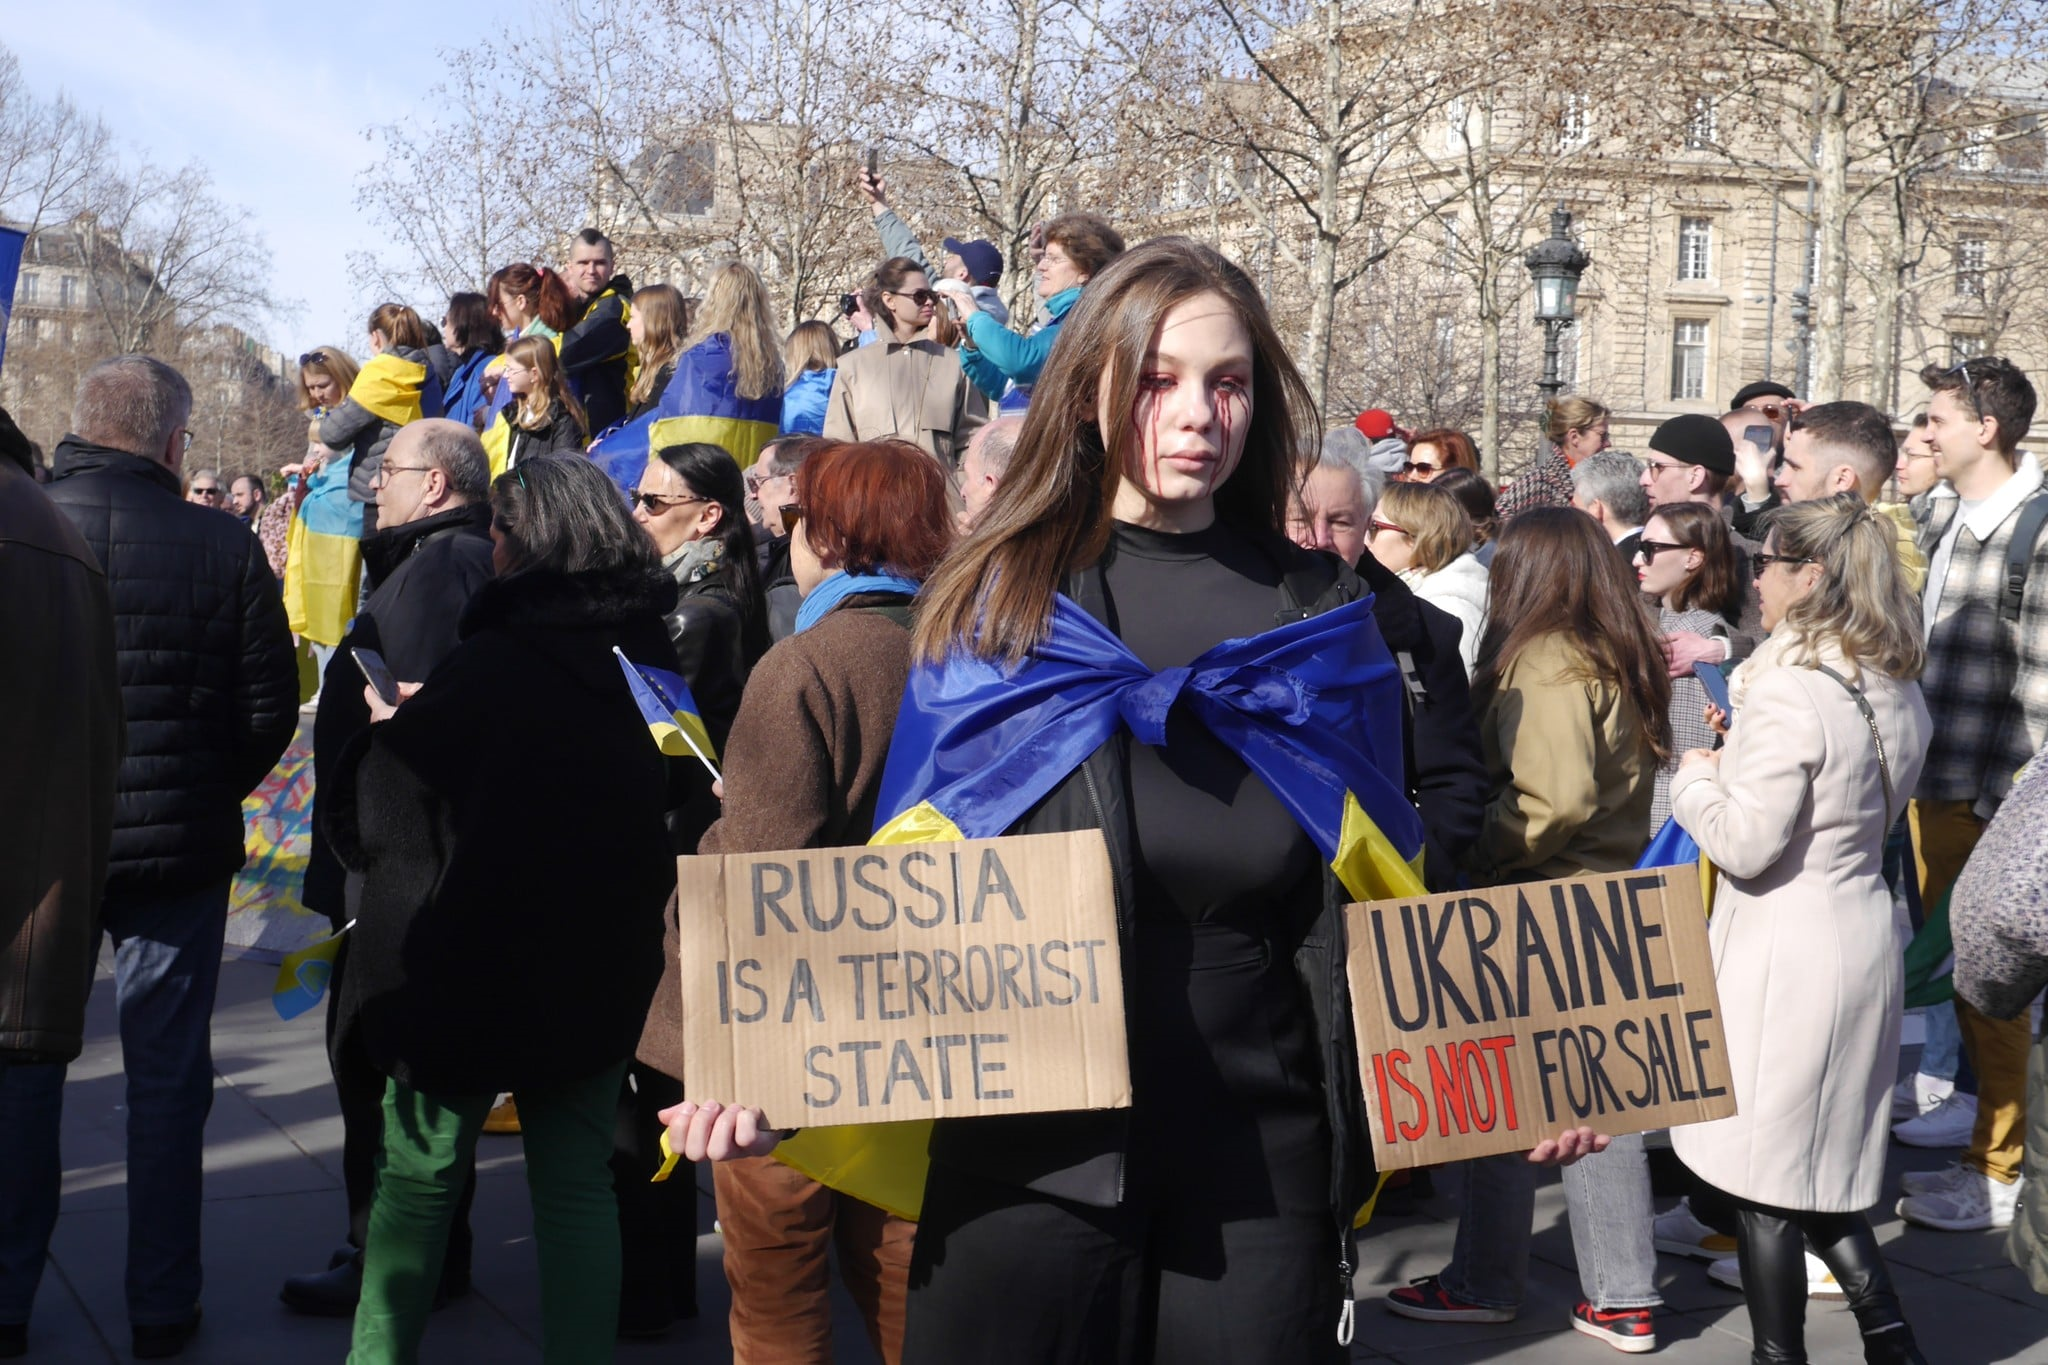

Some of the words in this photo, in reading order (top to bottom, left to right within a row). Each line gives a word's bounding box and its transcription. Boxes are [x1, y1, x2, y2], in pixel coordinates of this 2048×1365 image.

[751, 848, 1026, 936] RUSSIA
[716, 958, 768, 1024] IS
[781, 958, 825, 1023] A
[838, 939, 1106, 1021] TERRORIST
[1371, 875, 1684, 1032] UKRAINE
[803, 1034, 1014, 1108] STATE
[1373, 1048, 1429, 1144] IS
[1425, 1035, 1519, 1137] NOT
[1533, 1024, 1625, 1123] FOR
[1614, 1009, 1727, 1108] SALE
